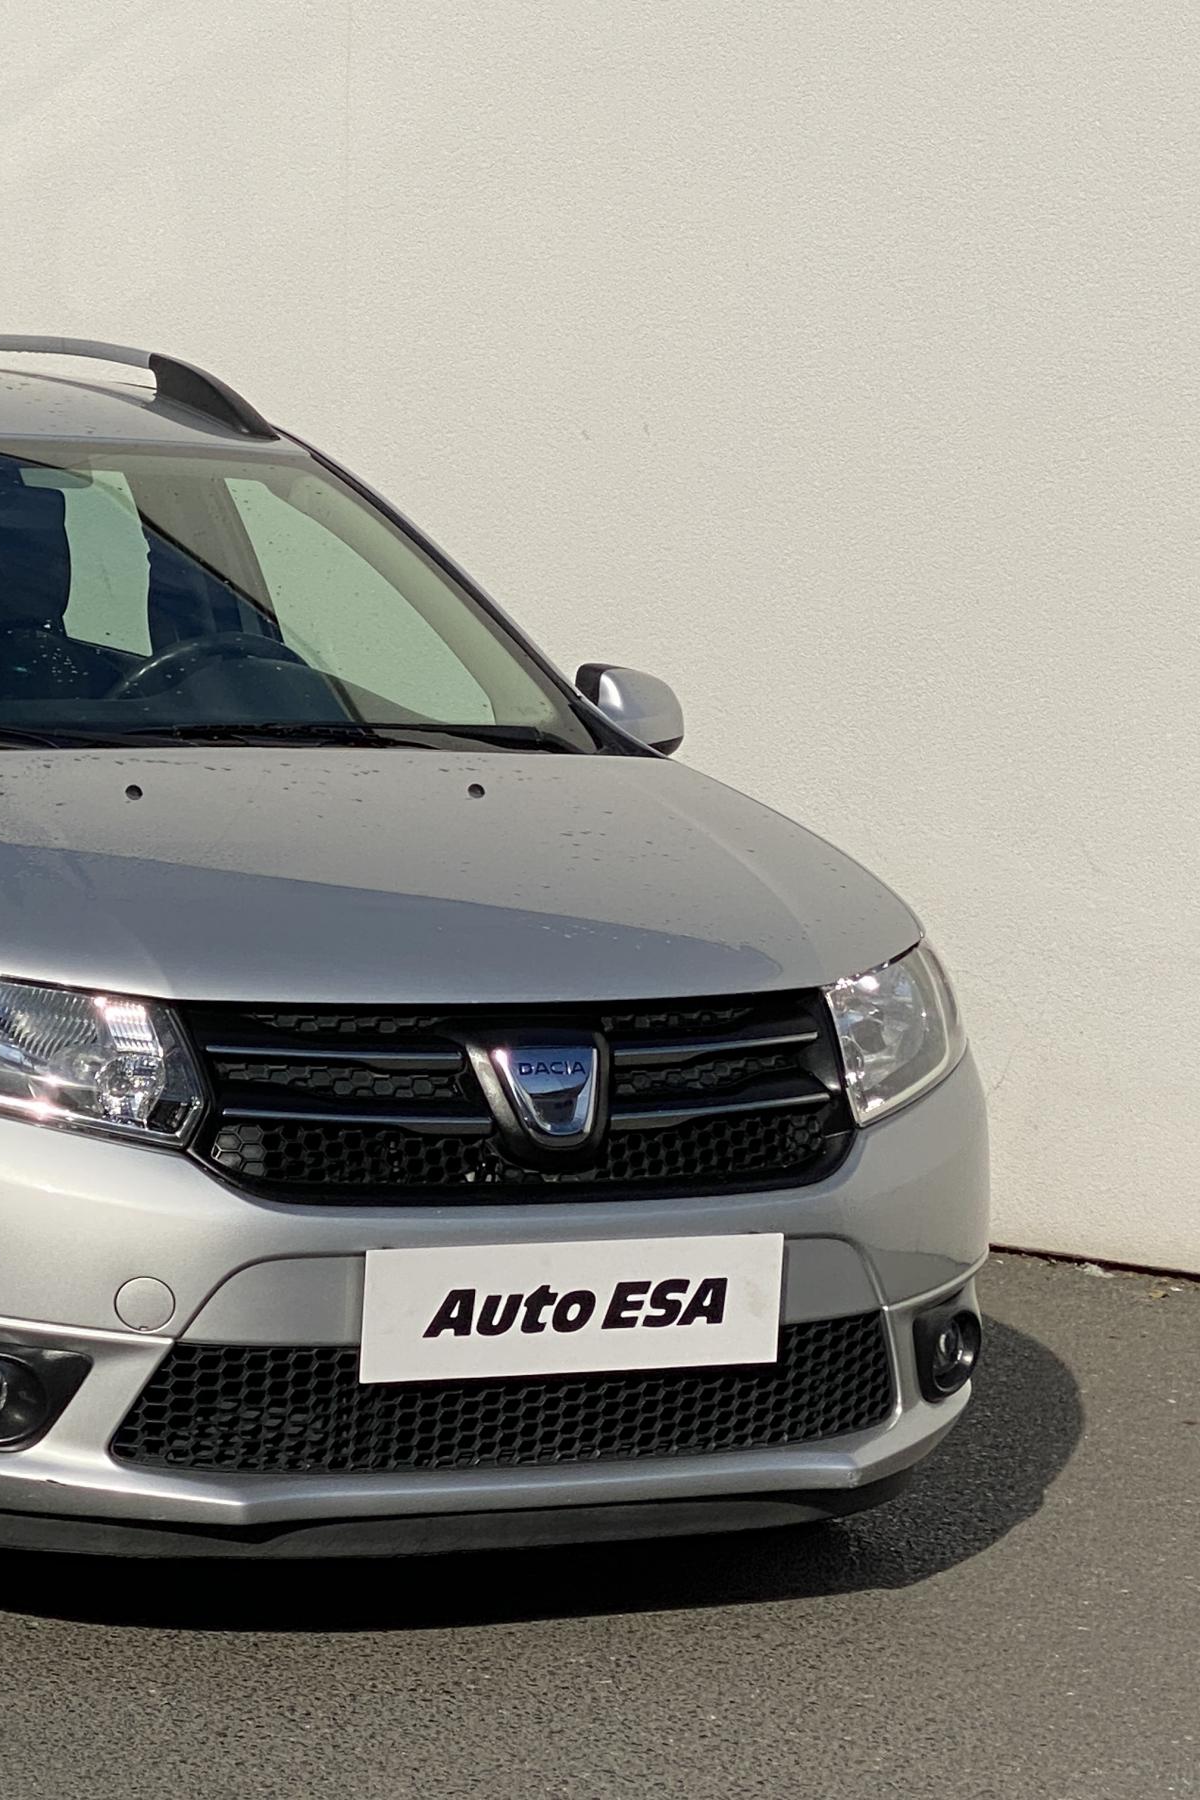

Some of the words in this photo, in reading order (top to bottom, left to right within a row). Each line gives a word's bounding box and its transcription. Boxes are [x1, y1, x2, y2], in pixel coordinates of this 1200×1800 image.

[518, 1061, 586, 1076] DACIA
[422, 1284, 596, 1338] Auto
[601, 1277, 728, 1329] ESA
